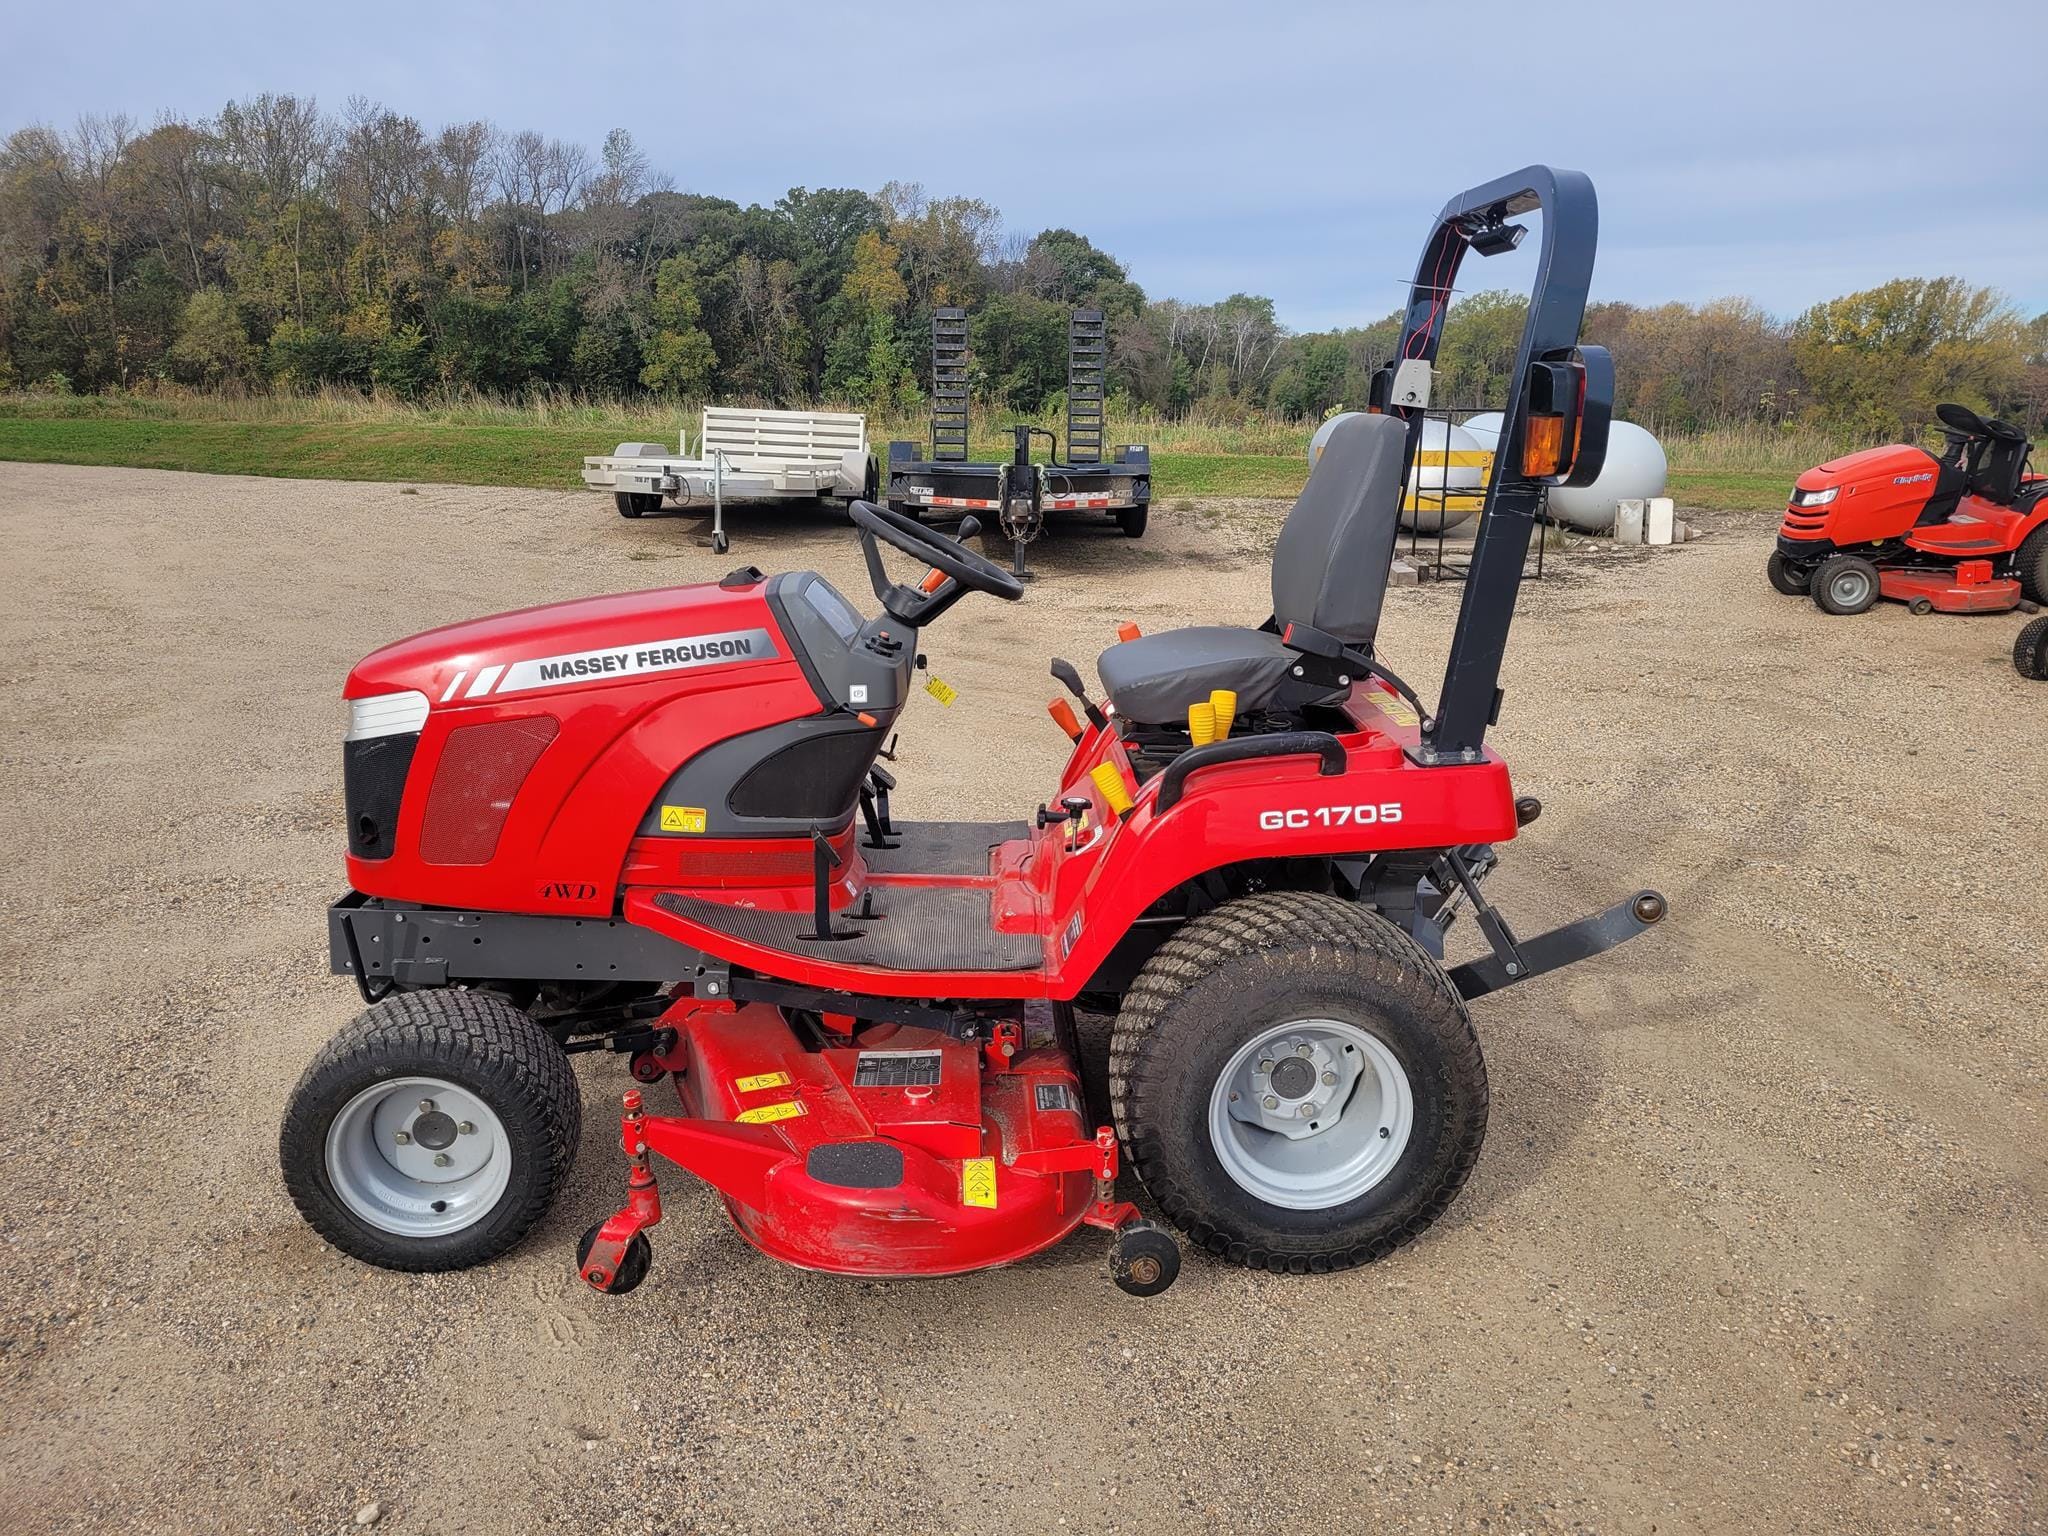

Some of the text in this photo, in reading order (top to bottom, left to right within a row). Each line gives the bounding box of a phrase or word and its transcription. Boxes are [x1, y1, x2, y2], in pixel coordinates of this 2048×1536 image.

[540, 638, 752, 681] MASSEY FERGUSON
[537, 882, 597, 900] 4WD
